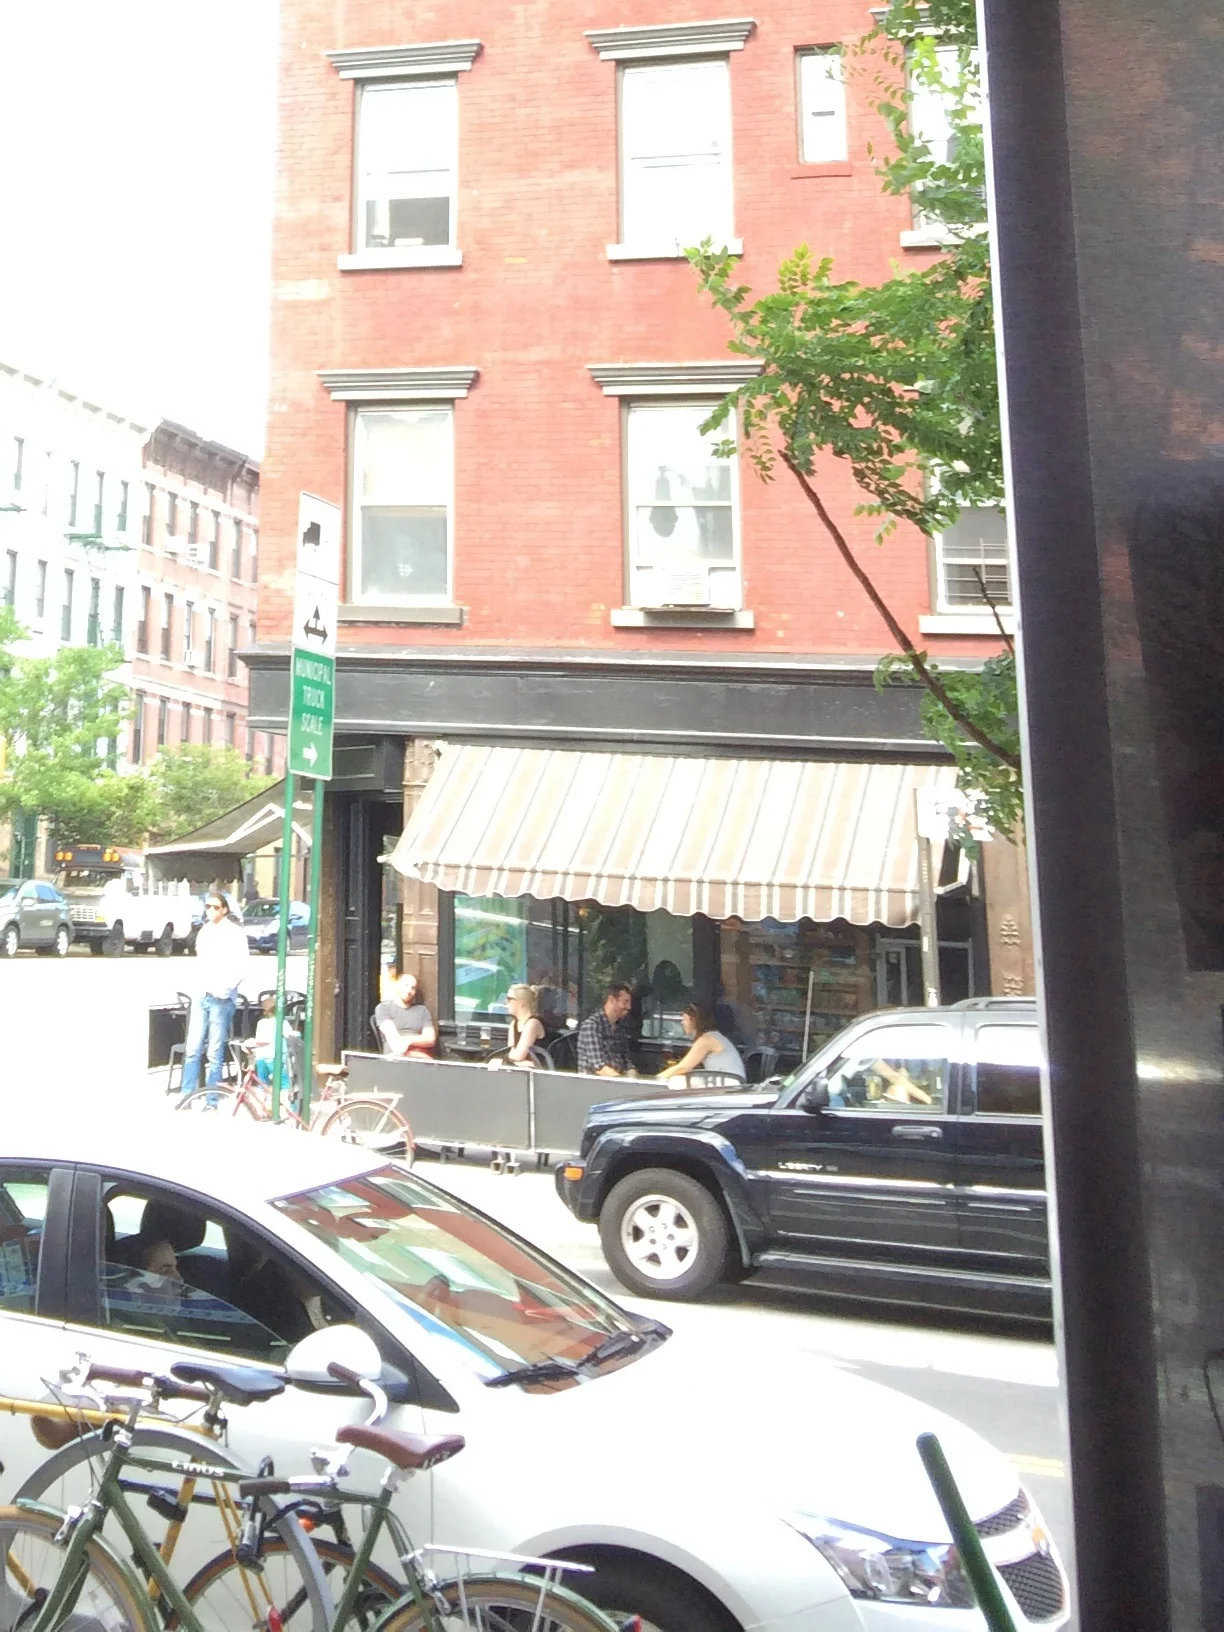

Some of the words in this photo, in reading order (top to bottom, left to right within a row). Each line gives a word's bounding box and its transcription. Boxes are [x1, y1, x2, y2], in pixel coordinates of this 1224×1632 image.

[295, 656, 332, 685] MUNICIPAL
[303, 685, 325, 709] TRUCK
[301, 713, 323, 735] SCALE
